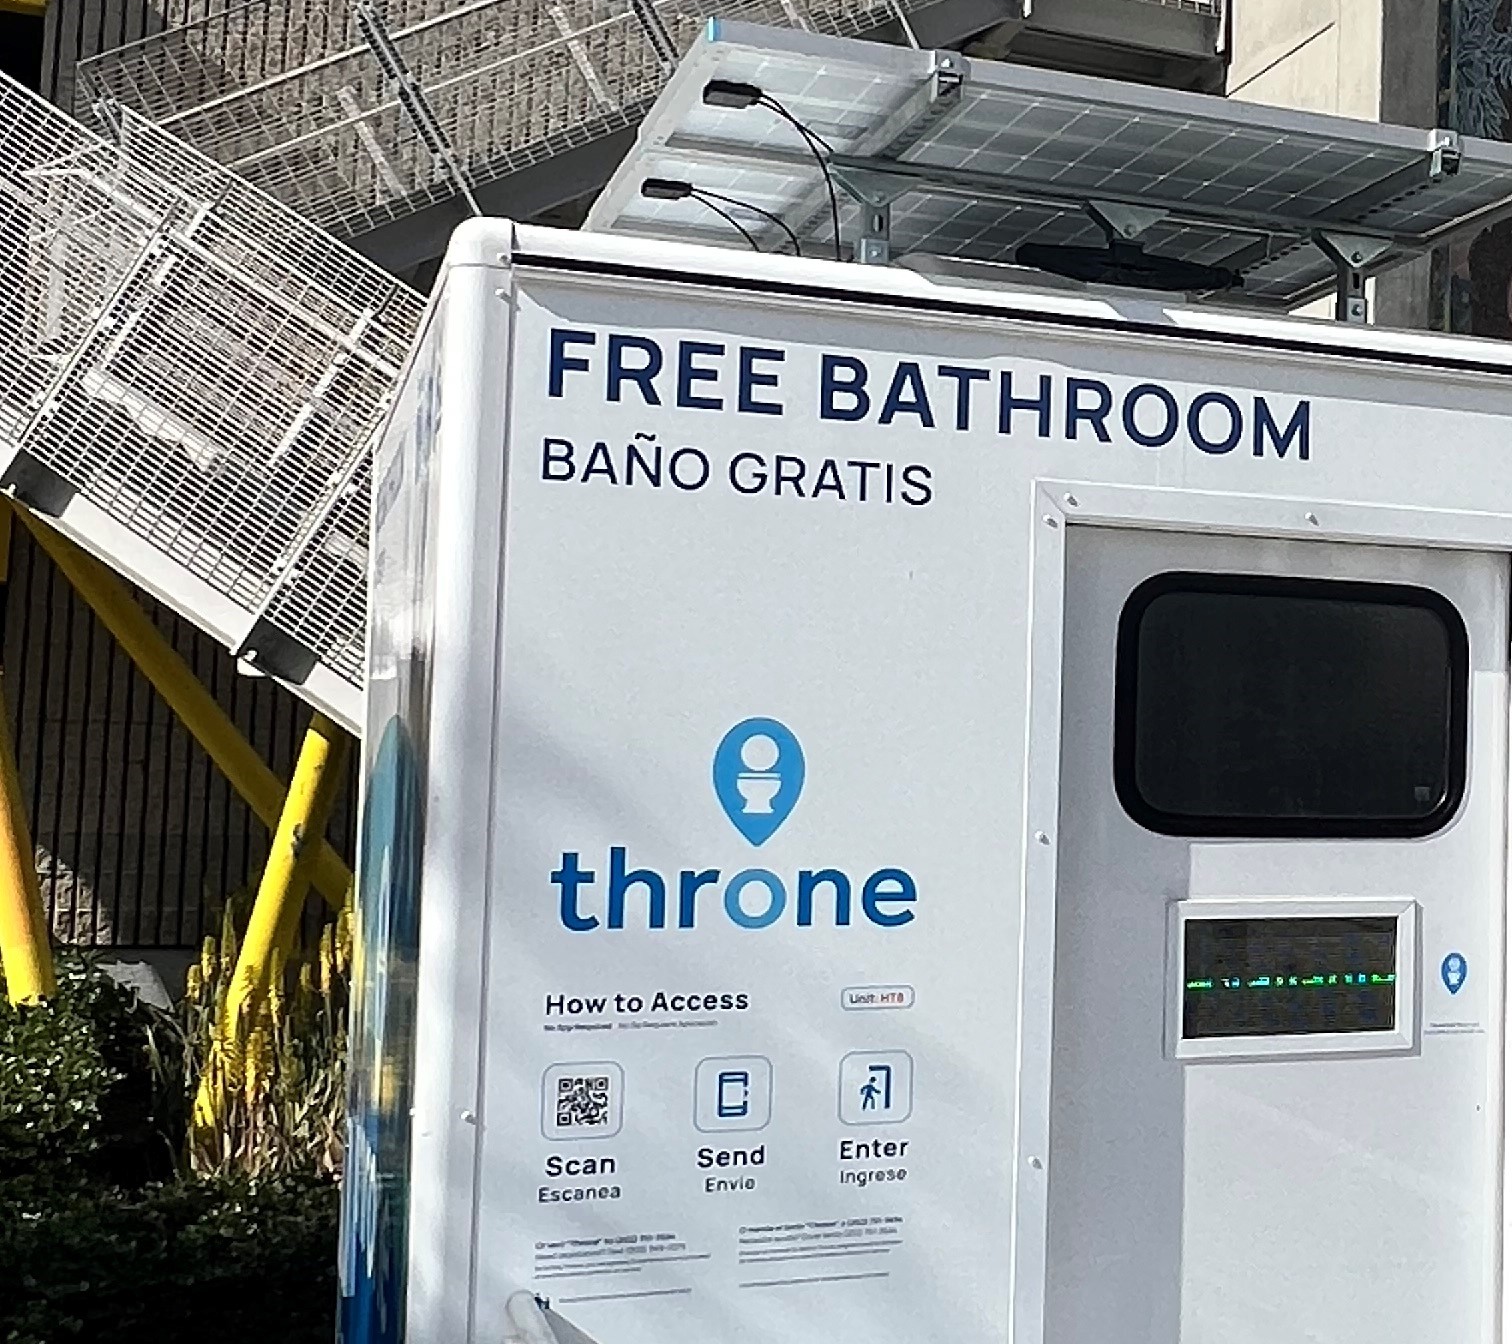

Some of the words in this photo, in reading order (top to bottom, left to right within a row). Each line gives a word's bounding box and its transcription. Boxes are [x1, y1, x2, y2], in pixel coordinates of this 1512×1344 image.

[548, 327, 787, 416] FREE
[820, 354, 1311, 460] BATHROOM
[541, 432, 710, 491] BAÑO
[731, 455, 932, 506] GRATIS
[551, 846, 917, 931] throne
[546, 994, 607, 1016] How
[614, 993, 643, 1013] to
[650, 991, 749, 1013] Access
[697, 1144, 764, 1168] Send
[841, 1139, 909, 1159] Enter
[546, 1155, 616, 1177] Scan
[538, 1185, 621, 1203] Escanea
